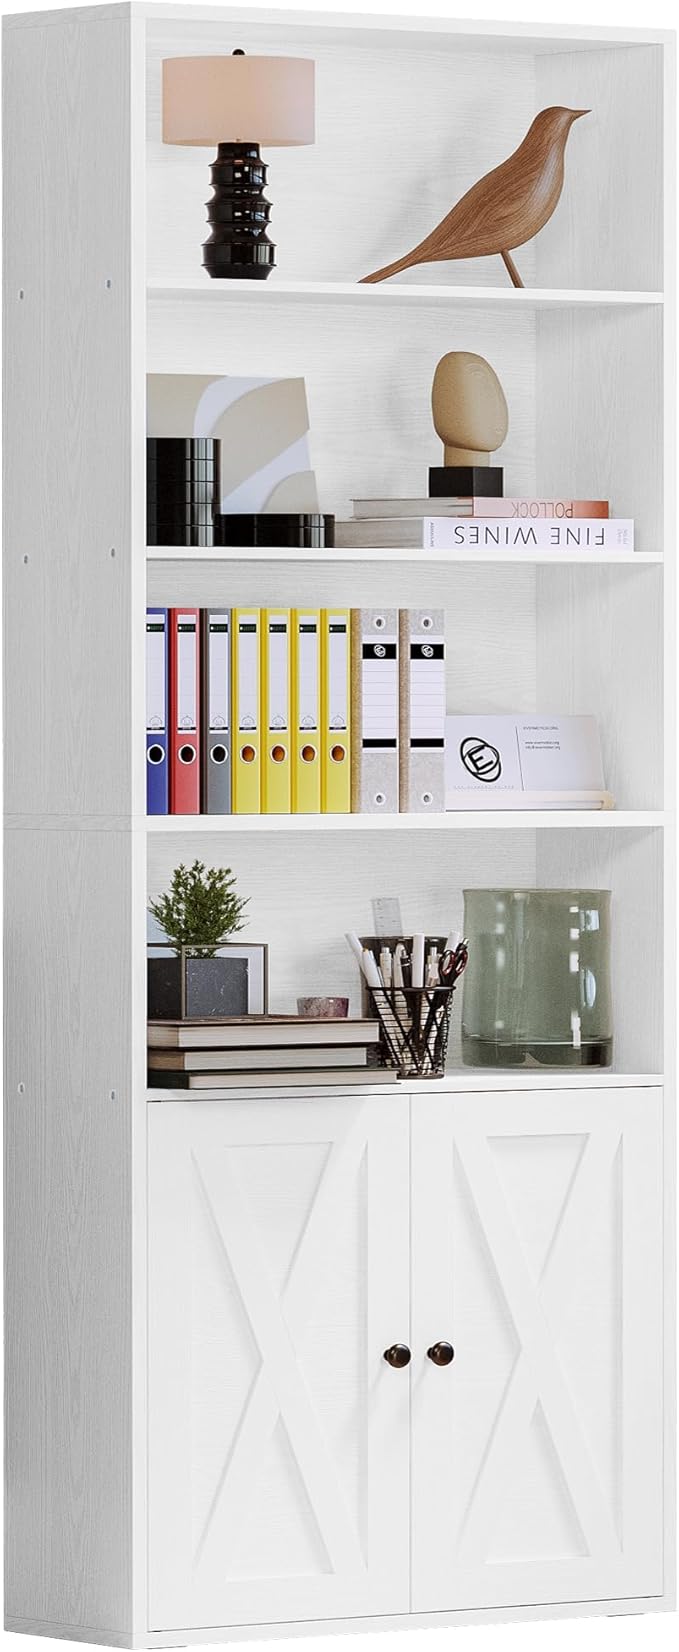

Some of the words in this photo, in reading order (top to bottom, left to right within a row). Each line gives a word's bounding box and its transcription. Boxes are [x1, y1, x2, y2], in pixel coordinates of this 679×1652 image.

[511, 502, 574, 519] POLLOCK
[454, 526, 538, 545] WINES
[550, 527, 605, 546] FINE
